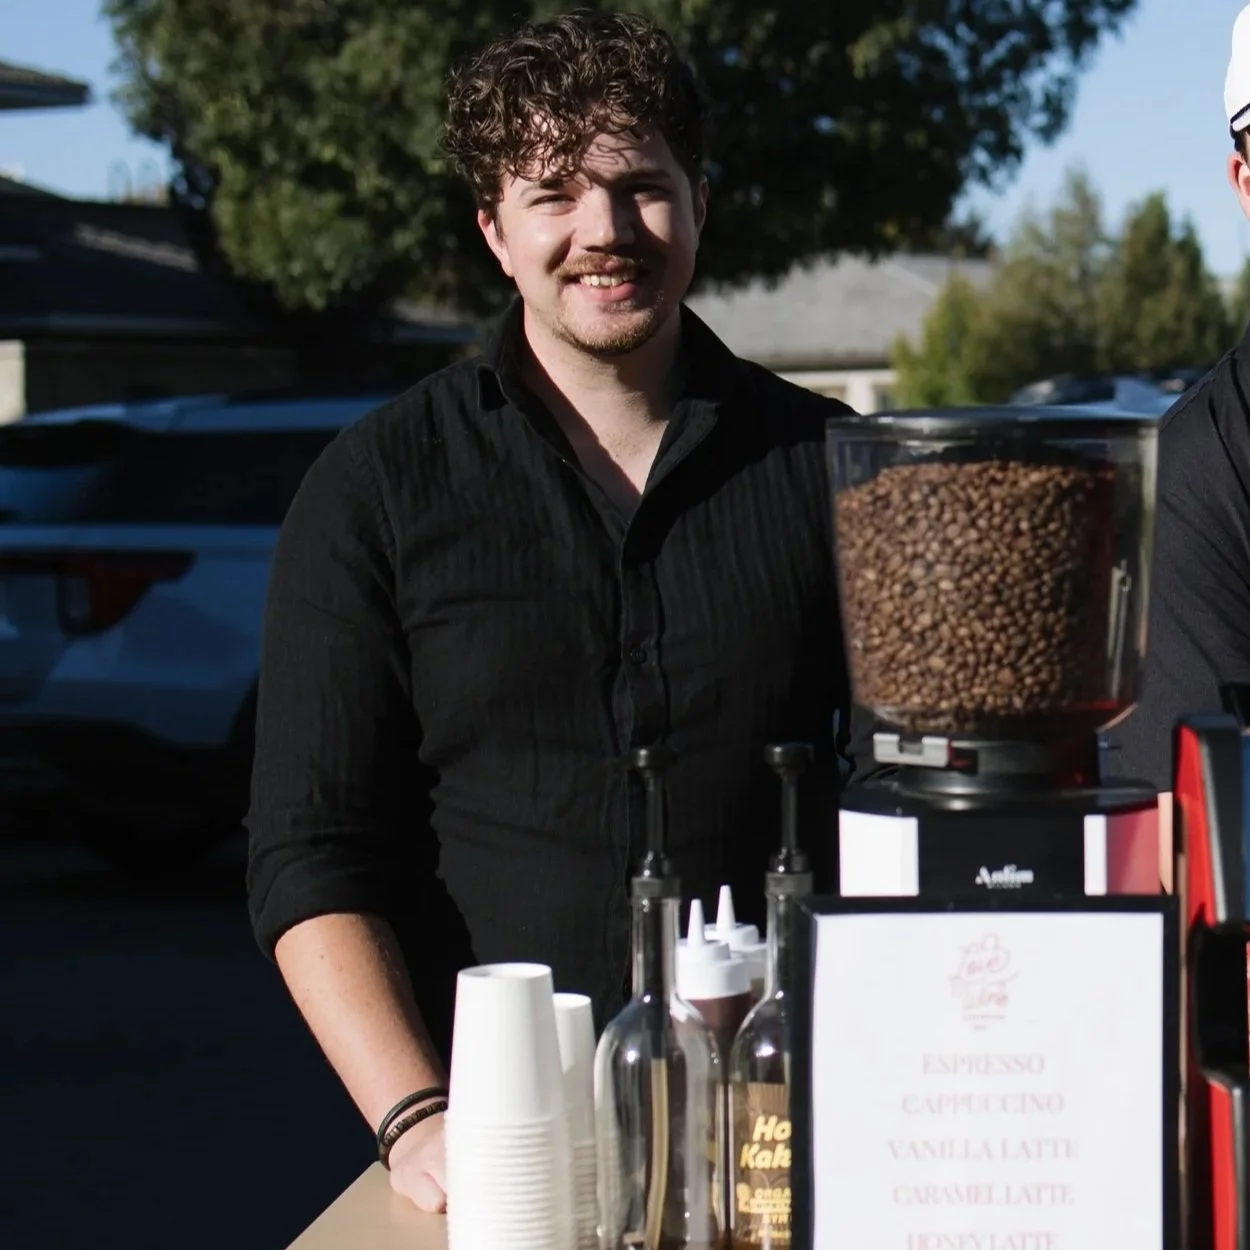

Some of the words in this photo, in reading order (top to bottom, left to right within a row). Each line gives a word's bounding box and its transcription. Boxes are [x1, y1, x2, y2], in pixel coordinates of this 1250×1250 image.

[922, 1053, 1045, 1075] ESPRESSO
[901, 1092, 1065, 1115] CAPPUCCINO
[887, 1138, 993, 1161] VANILLA
[1001, 1137, 1079, 1161] LATTE
[892, 1183, 1000, 1206] CARAMEL
[1004, 1182, 1076, 1206] LATTE
